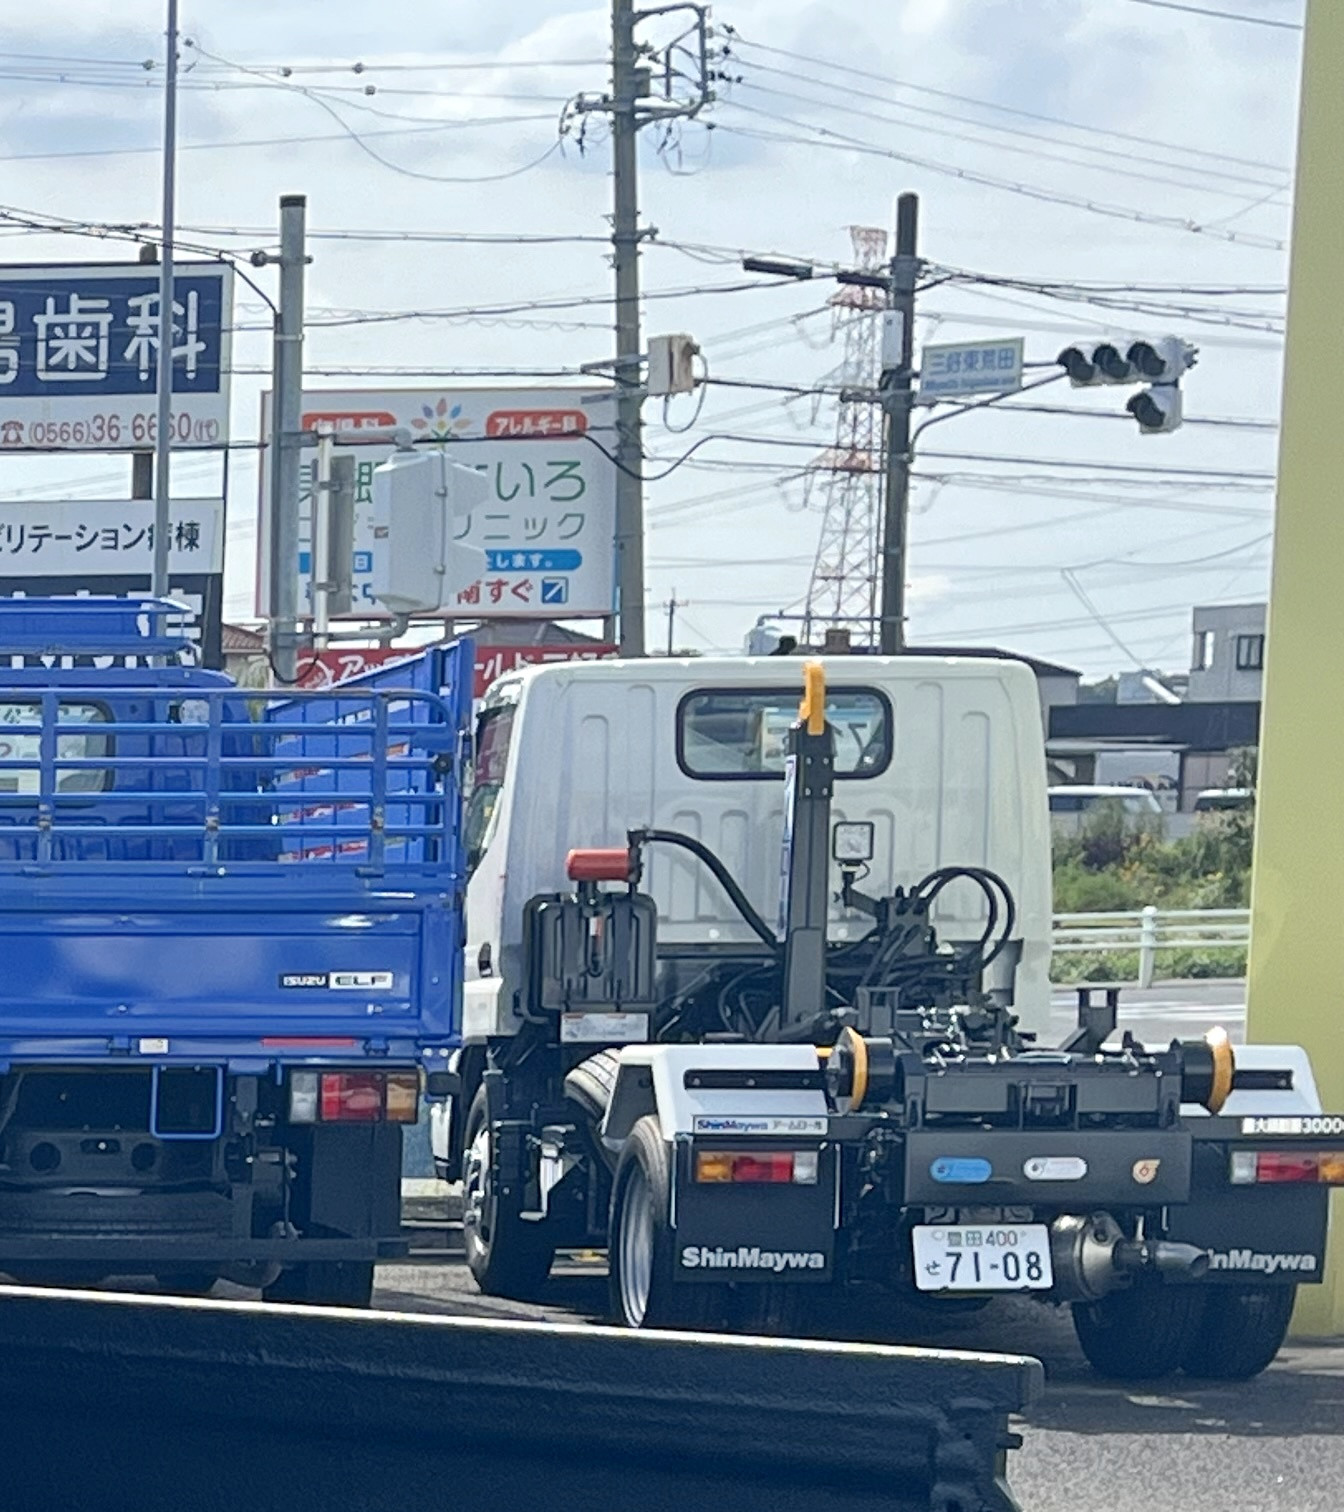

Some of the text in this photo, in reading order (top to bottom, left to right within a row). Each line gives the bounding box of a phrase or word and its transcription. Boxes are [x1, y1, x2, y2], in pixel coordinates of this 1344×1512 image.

[985, 1230, 1018, 1247] 400
[681, 1246, 825, 1273] ShinMaywa
[945, 1251, 1043, 1282] 71-08
[1206, 1248, 1317, 1274] inMaywa
